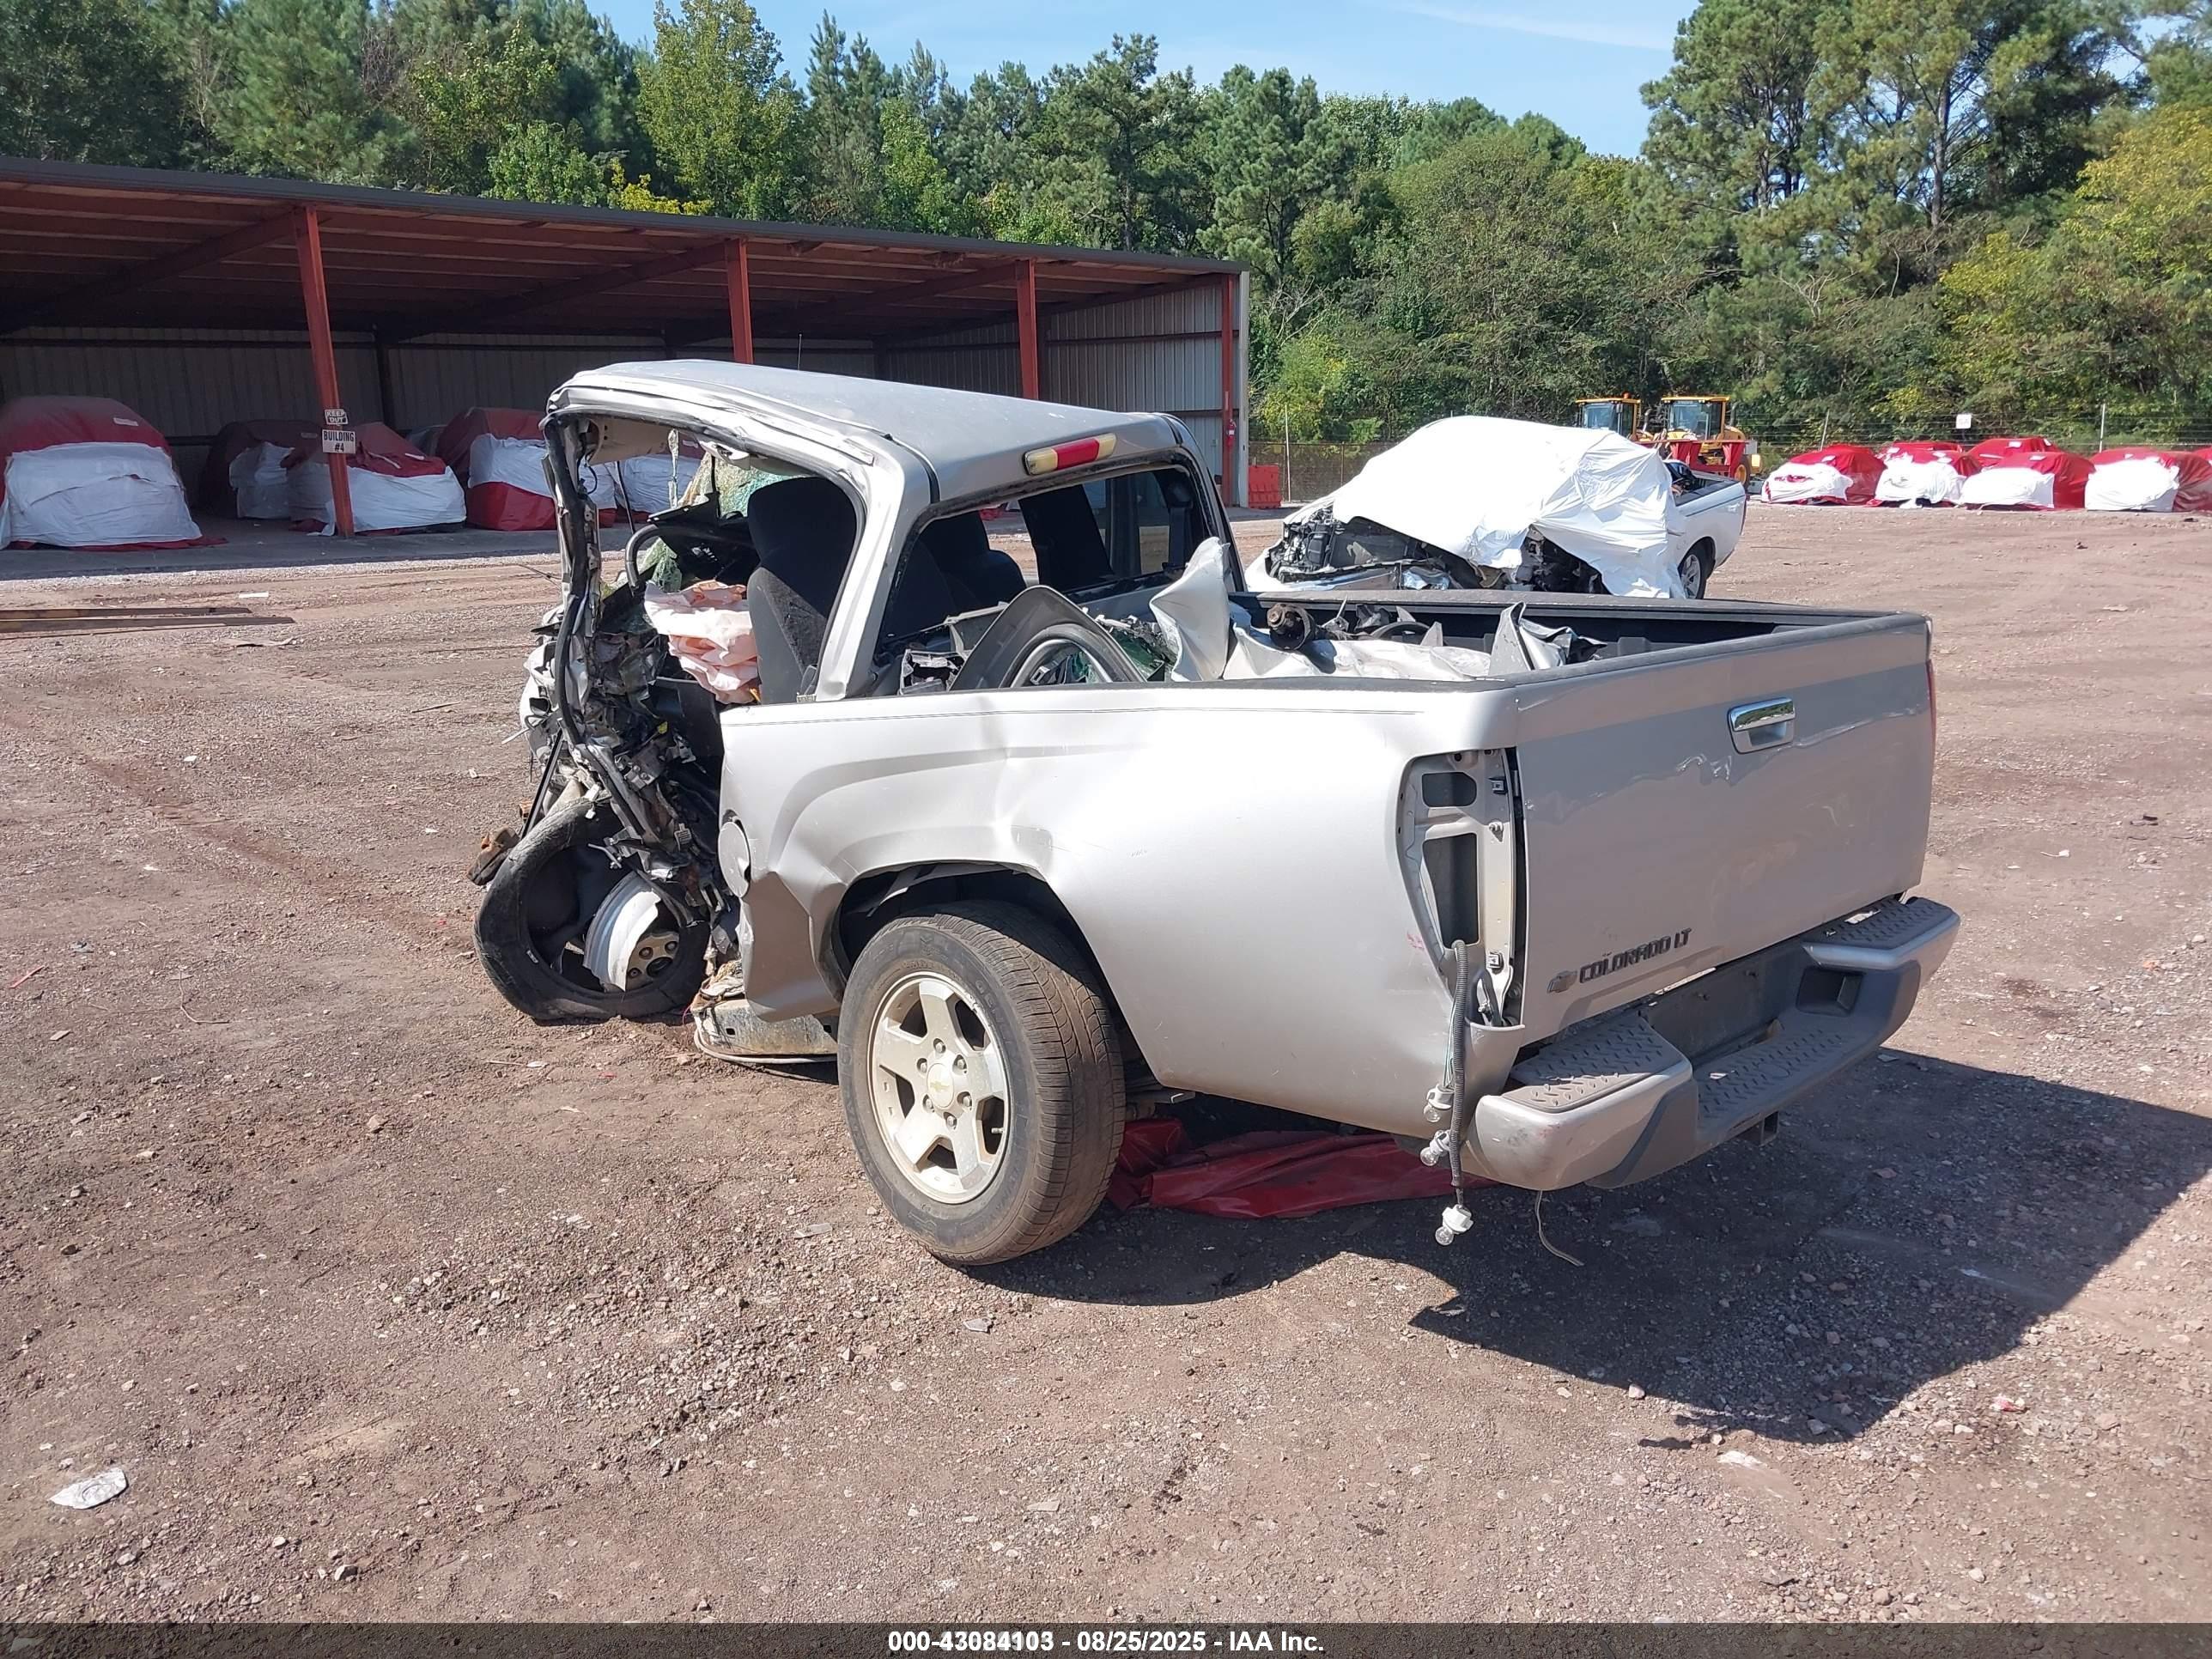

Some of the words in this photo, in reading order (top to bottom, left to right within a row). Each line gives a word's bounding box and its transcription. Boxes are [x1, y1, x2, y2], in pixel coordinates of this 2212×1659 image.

[324, 430, 355, 442] BUILDING
[334, 442, 344, 453] #4
[1579, 935, 1672, 983] COLORADO
[1674, 927, 1692, 949] LT
